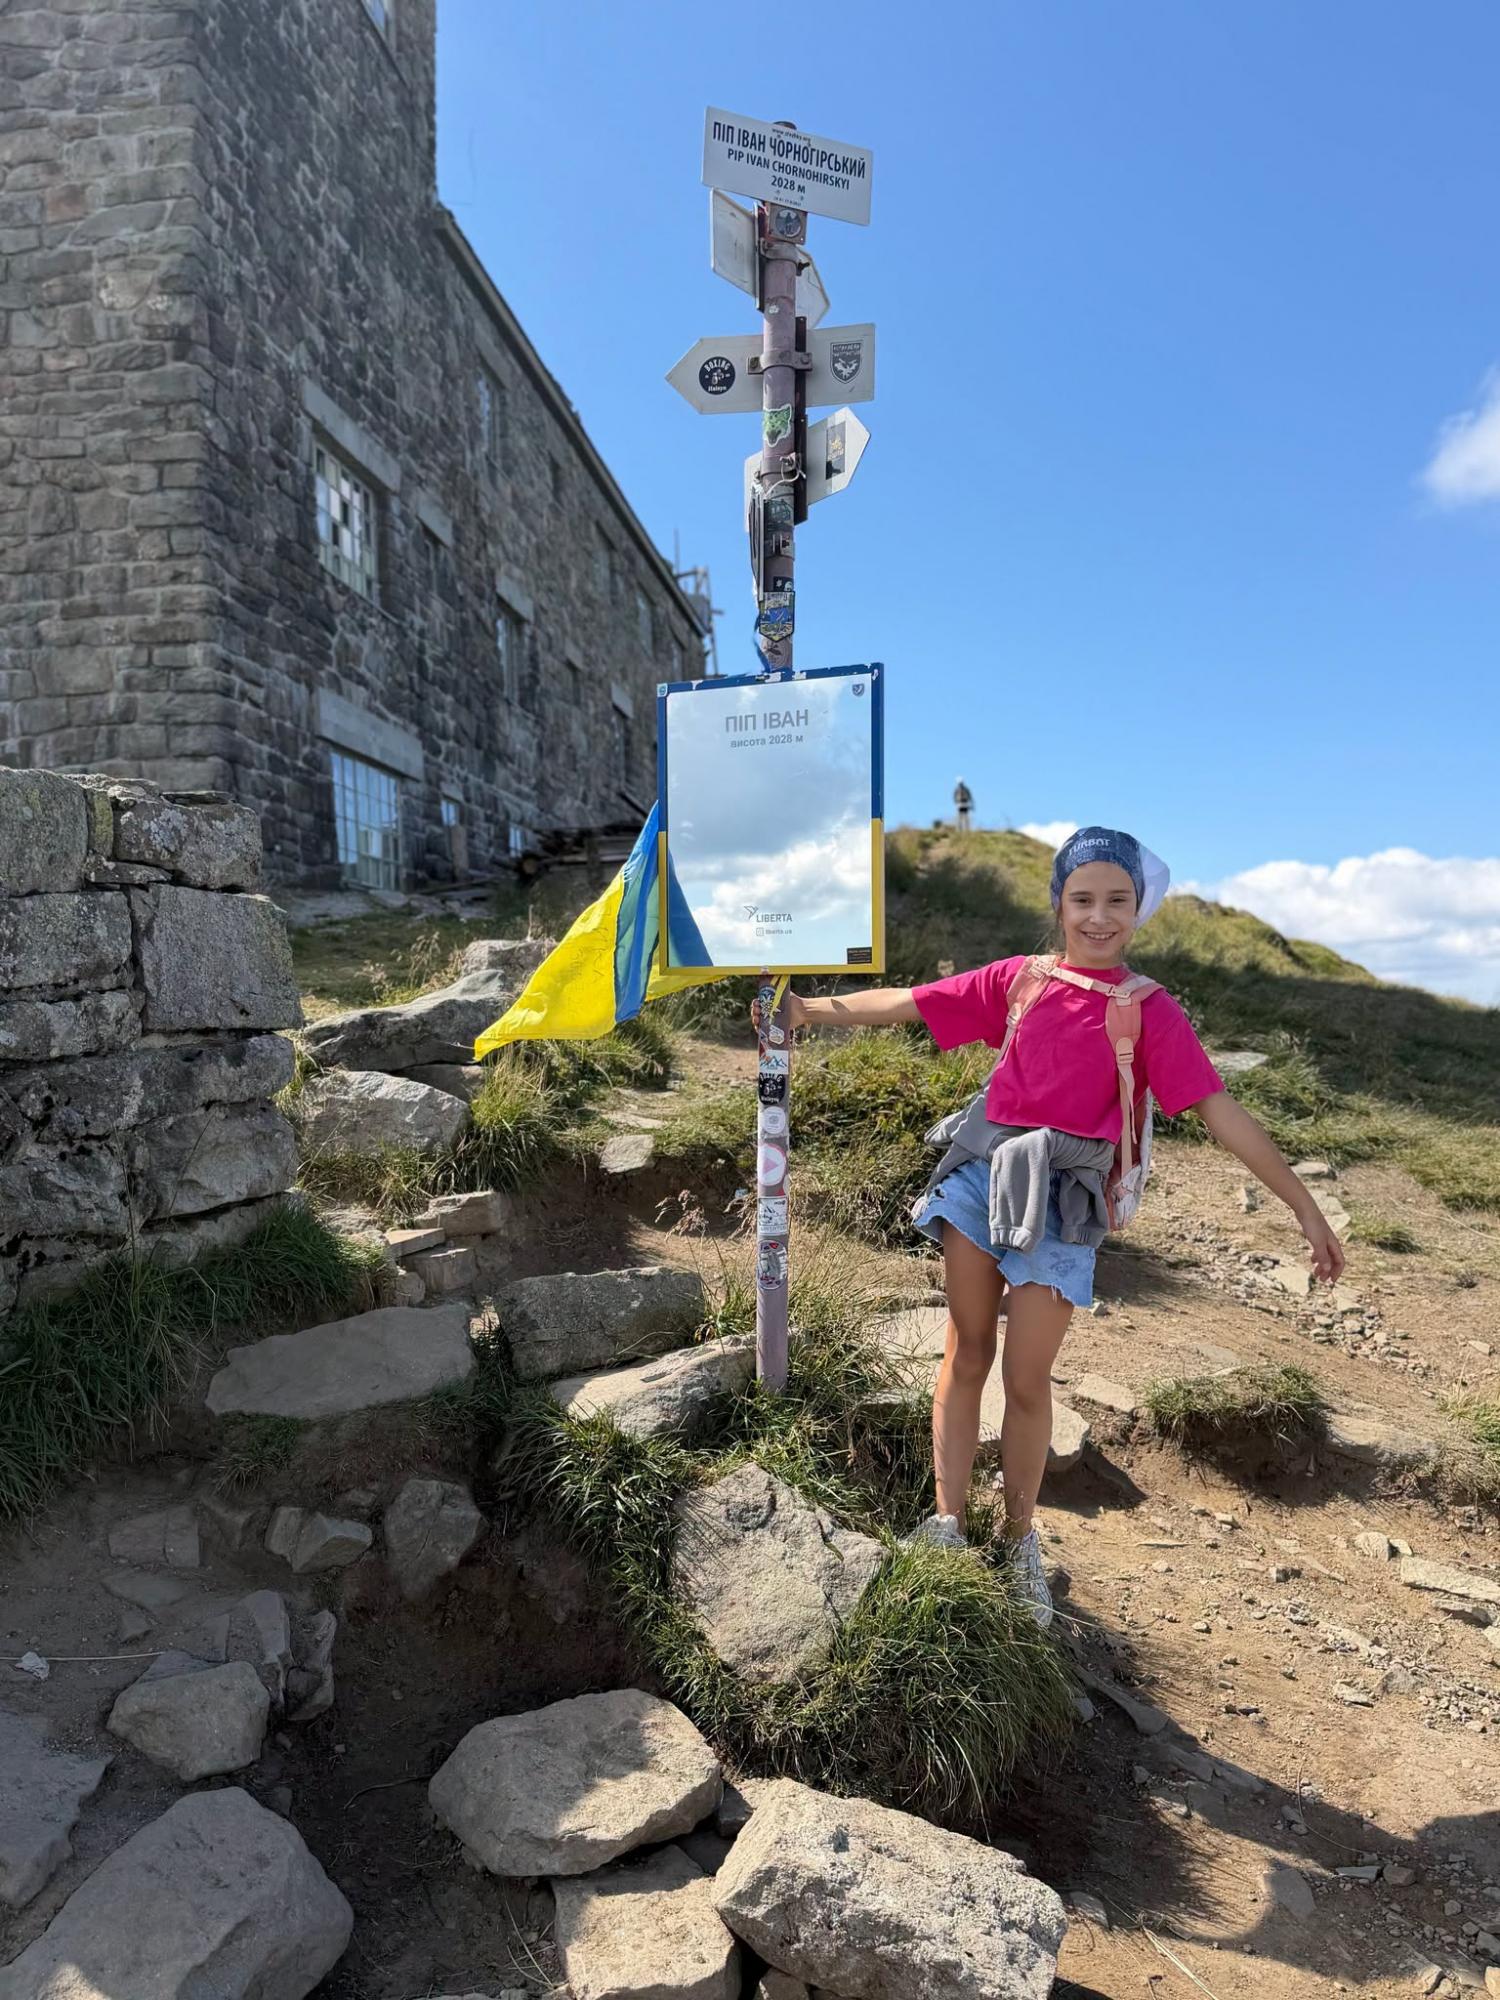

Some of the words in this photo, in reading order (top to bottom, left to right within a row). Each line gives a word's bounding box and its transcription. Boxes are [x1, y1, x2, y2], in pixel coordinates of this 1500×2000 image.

[713, 121, 734, 144] ПІП
[737, 128, 766, 153] ІВАН
[769, 136, 866, 179] ЧОРНОГІРСЬКИЙ
[728, 148, 745, 161] PIP
[746, 151, 770, 169] IVAN
[772, 160, 850, 190] CHORNOHIRSKYI
[771, 175, 796, 191] 2028
[704, 359, 731, 372] BOXING
[725, 714, 757, 734] ПІП
[763, 708, 809, 730] ІВАН
[730, 736, 766, 749] висота
[768, 734, 793, 745] 2028
[756, 913, 793, 923] LIBERTA
